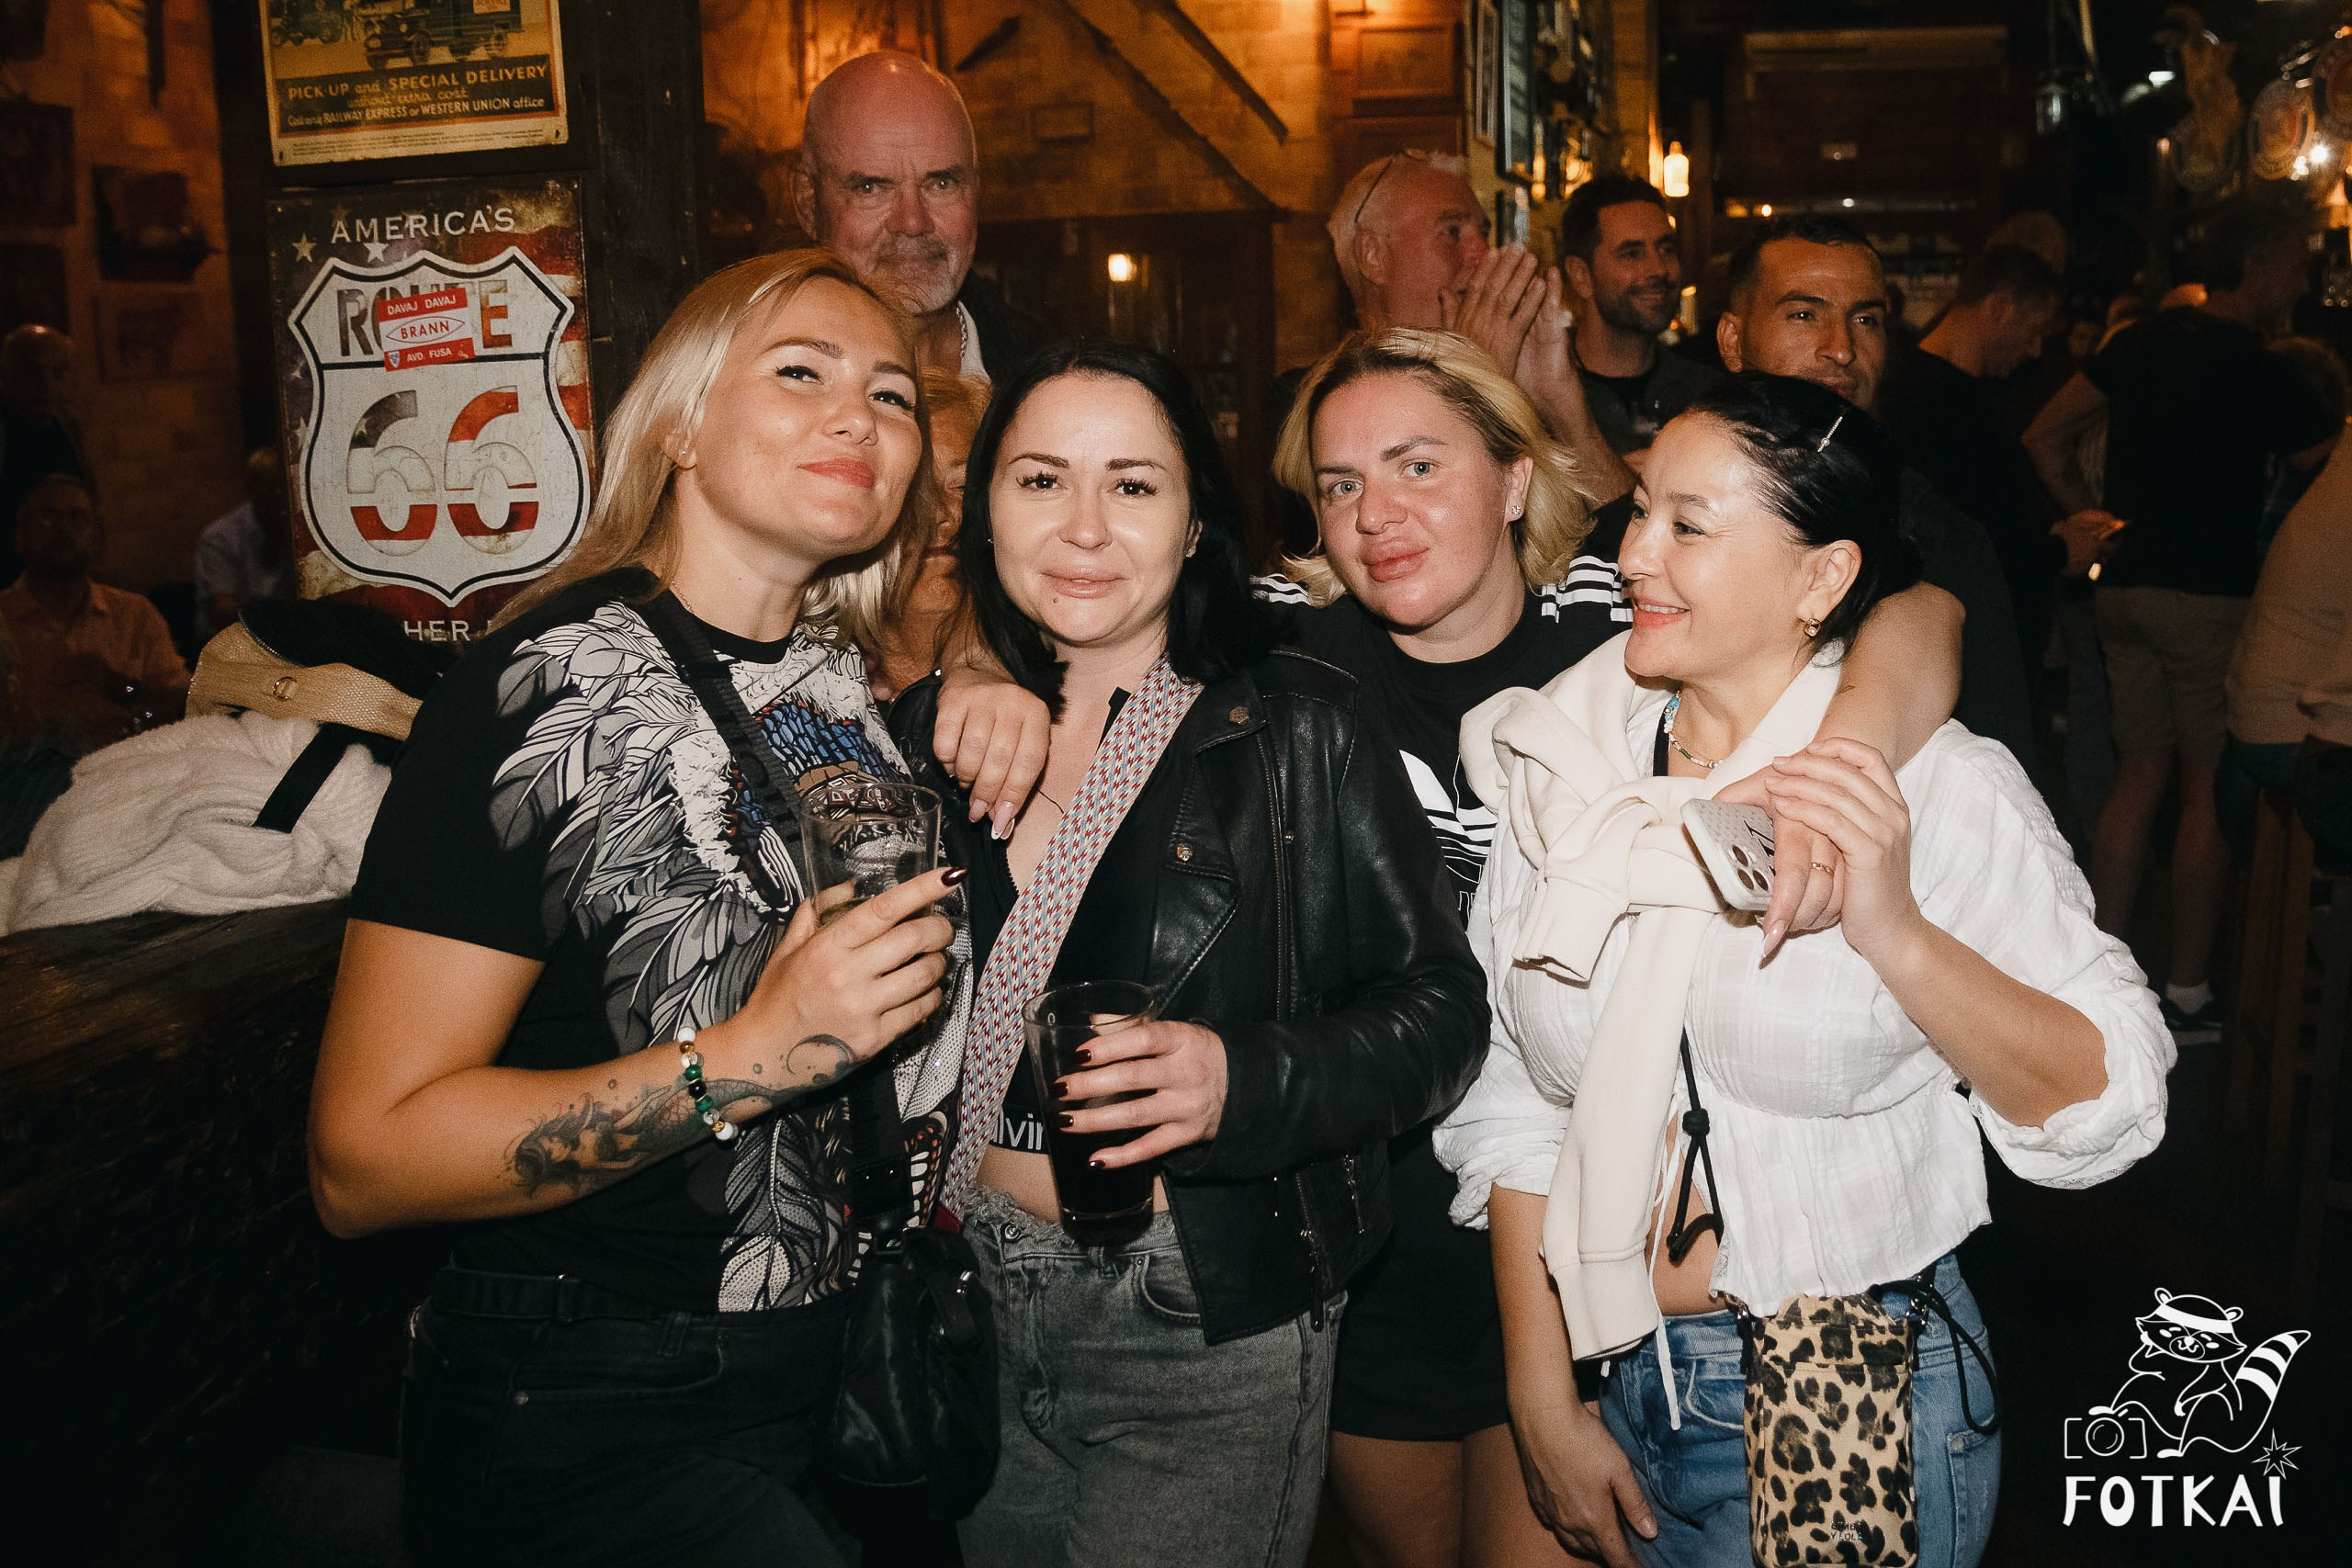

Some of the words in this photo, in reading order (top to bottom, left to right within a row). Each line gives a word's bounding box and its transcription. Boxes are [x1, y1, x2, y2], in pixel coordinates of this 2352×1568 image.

[288, 86, 323, 101] PICK
[328, 84, 348, 96] UP
[390, 73, 459, 92] SPECIAL
[466, 65, 548, 85] DELIVERY
[323, 109, 362, 124] RAILWAY
[366, 106, 407, 120] EXPRESS
[420, 101, 469, 116] WESTERN
[472, 97, 511, 111] UNION
[514, 96, 545, 108] office
[331, 207, 515, 244] AMERICA'S
[387, 301, 418, 315] DAVAJ
[424, 294, 457, 309] DAVAJ
[401, 320, 450, 339] BRANN
[428, 347, 452, 359] FUSA
[345, 385, 540, 557] 66
